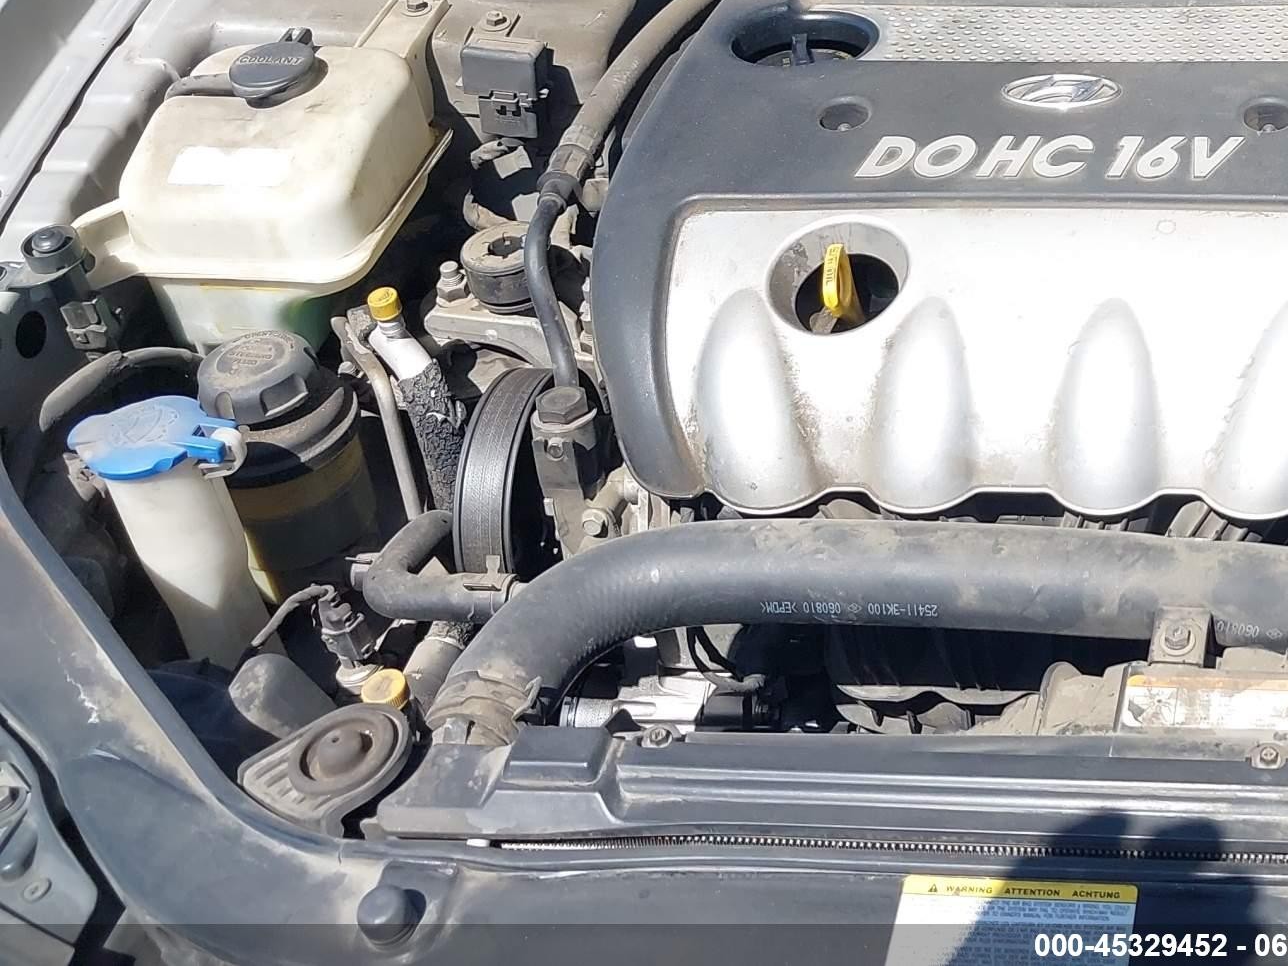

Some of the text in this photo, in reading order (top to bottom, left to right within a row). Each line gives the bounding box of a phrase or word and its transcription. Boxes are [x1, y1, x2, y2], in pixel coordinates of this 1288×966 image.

[239, 55, 305, 66] COOLANT
[854, 135, 1246, 179] DOHC 16V
[803, 601, 841, 614] 060810
[867, 602, 938, 617] 25411-3K100
[1216, 620, 1260, 638] 060810
[946, 886, 1121, 899] WARNING ATTENTION ACHTUNG
